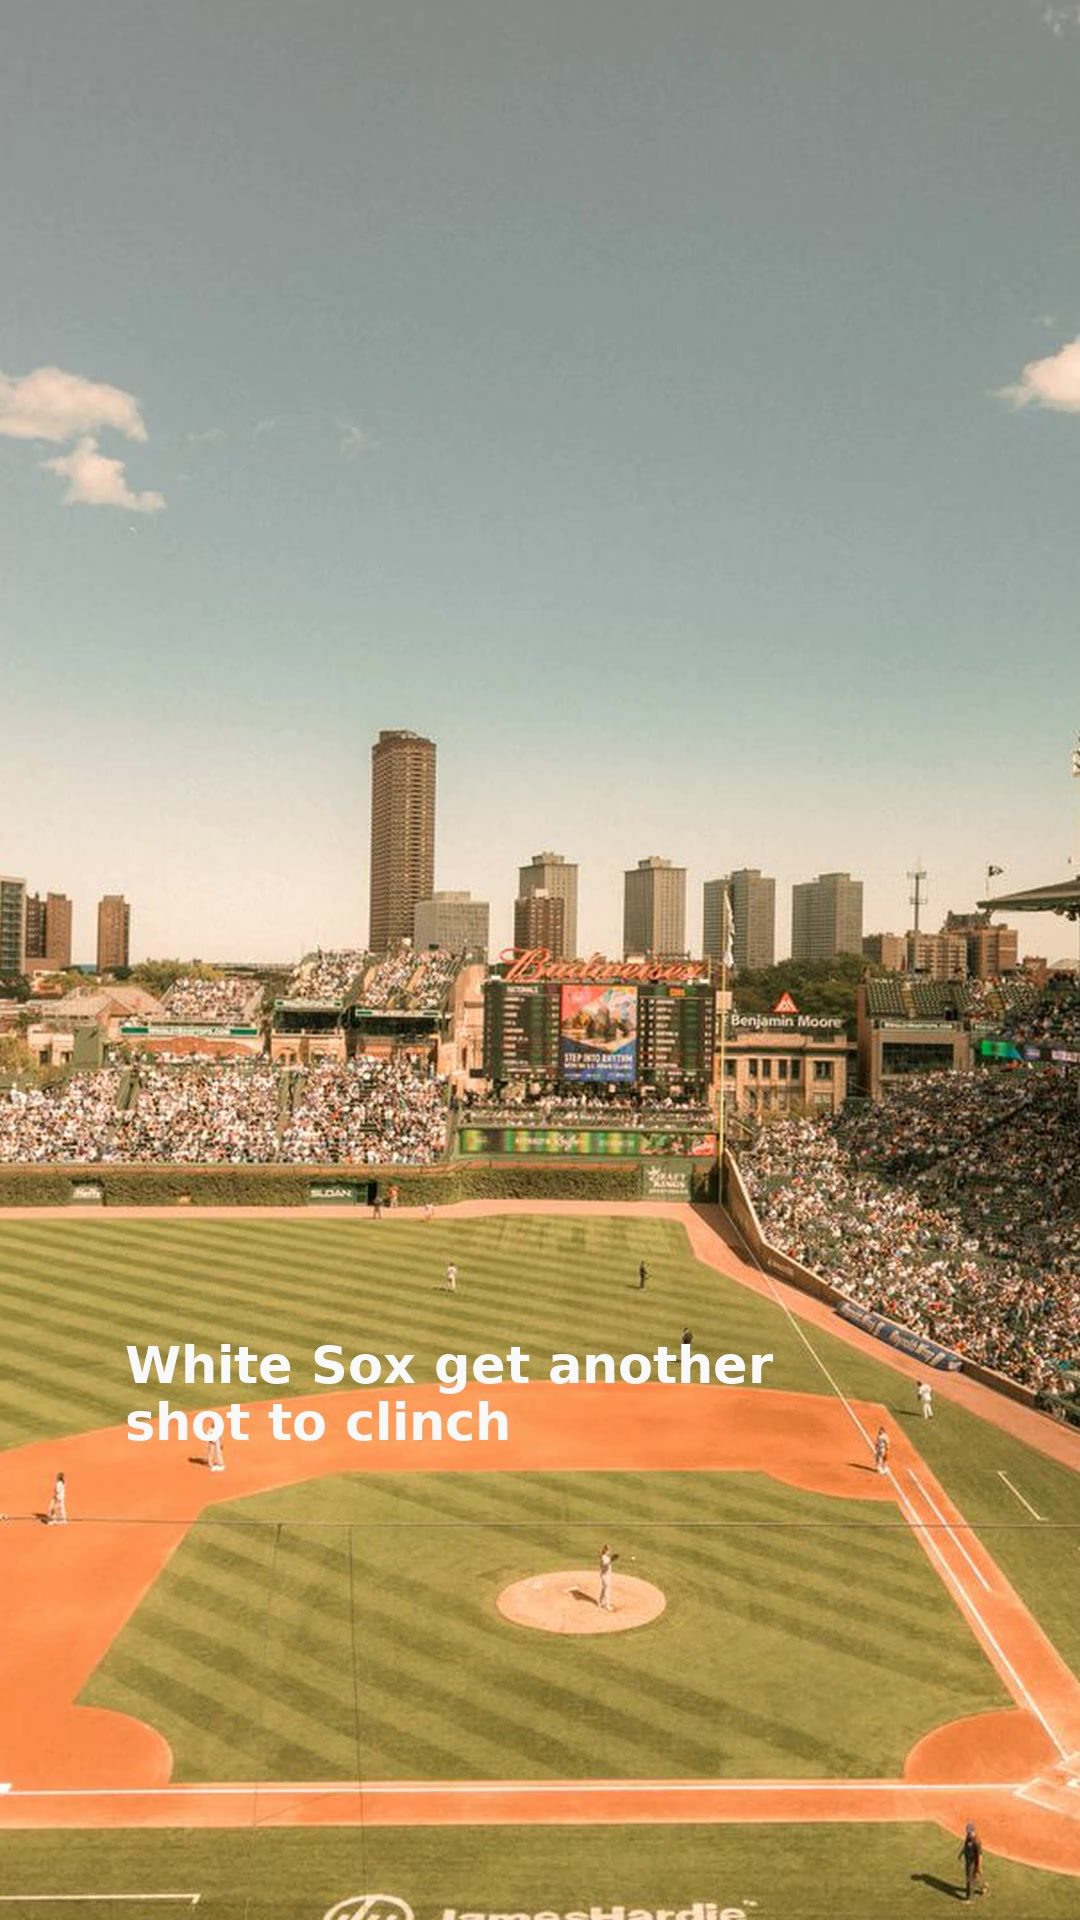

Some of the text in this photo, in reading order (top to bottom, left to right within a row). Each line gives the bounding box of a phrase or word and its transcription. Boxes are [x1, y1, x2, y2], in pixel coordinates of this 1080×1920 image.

[499, 948, 706, 984] Budweiser
[731, 1014, 842, 1029] Benjamin Moore
[564, 1053, 582, 1062] STEP
[583, 1053, 601, 1062] INTO
[311, 1188, 353, 1198] SLOAN
